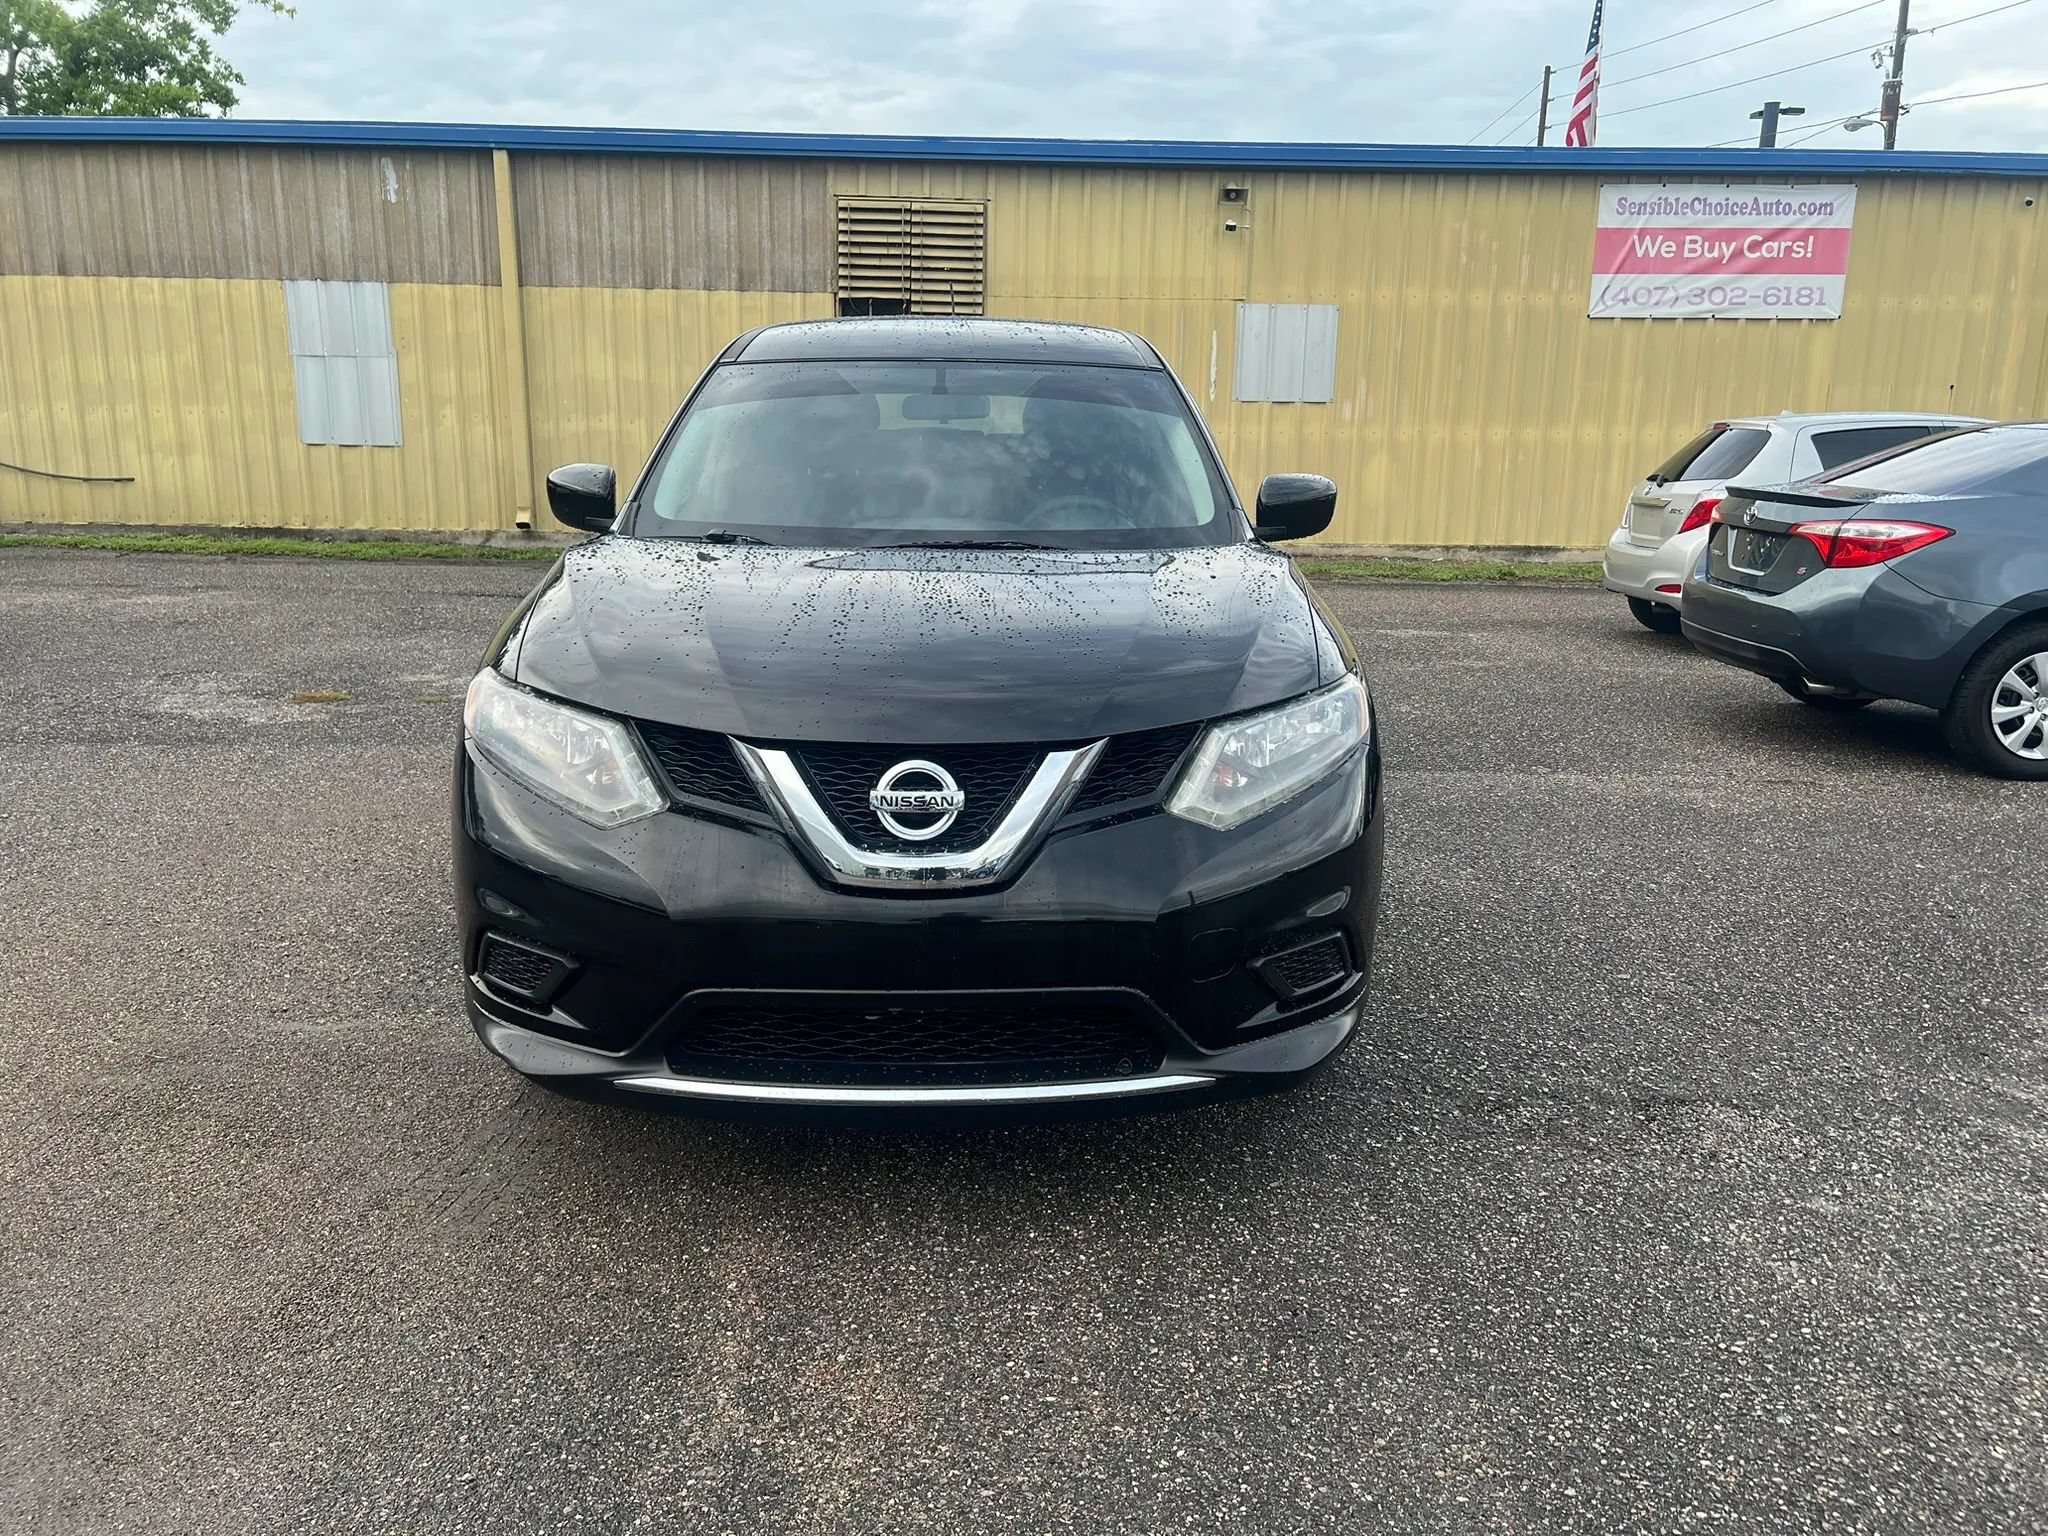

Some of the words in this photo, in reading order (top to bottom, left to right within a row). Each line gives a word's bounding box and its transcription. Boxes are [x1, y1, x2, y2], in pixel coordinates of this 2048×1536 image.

[1616, 196, 1834, 216] SensibleChoiceAuto.com
[1633, 235, 1676, 258] We
[1683, 235, 1736, 264] Buy
[1743, 235, 1814, 258] Cars!
[1600, 284, 1679, 308] (407)
[1687, 286, 1826, 306] 302-6181
[880, 795, 954, 807] NISSAN
